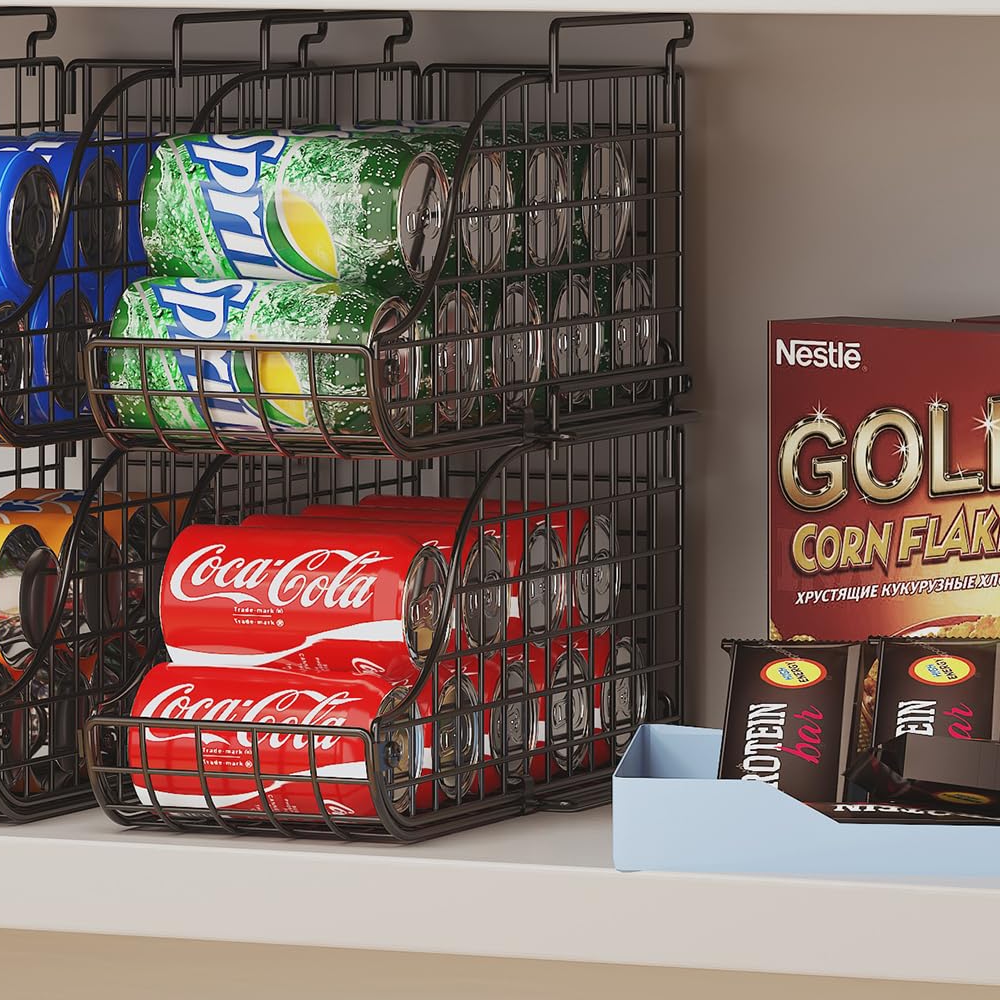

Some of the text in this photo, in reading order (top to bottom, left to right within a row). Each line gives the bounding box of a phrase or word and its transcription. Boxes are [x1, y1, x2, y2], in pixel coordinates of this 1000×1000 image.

[778, 394, 1000, 512] GOL
[792, 503, 1000, 575] CORN FLAK
[170, 544, 394, 610] Coca-Cola
[795, 574, 1000, 604] ХРУСТЯЩИЕ КУКУРУЗНЫЕ ХЛ
[785, 661, 809, 683] ENERGY
[934, 658, 957, 680] ENERGY
[776, 704, 824, 764] bar
